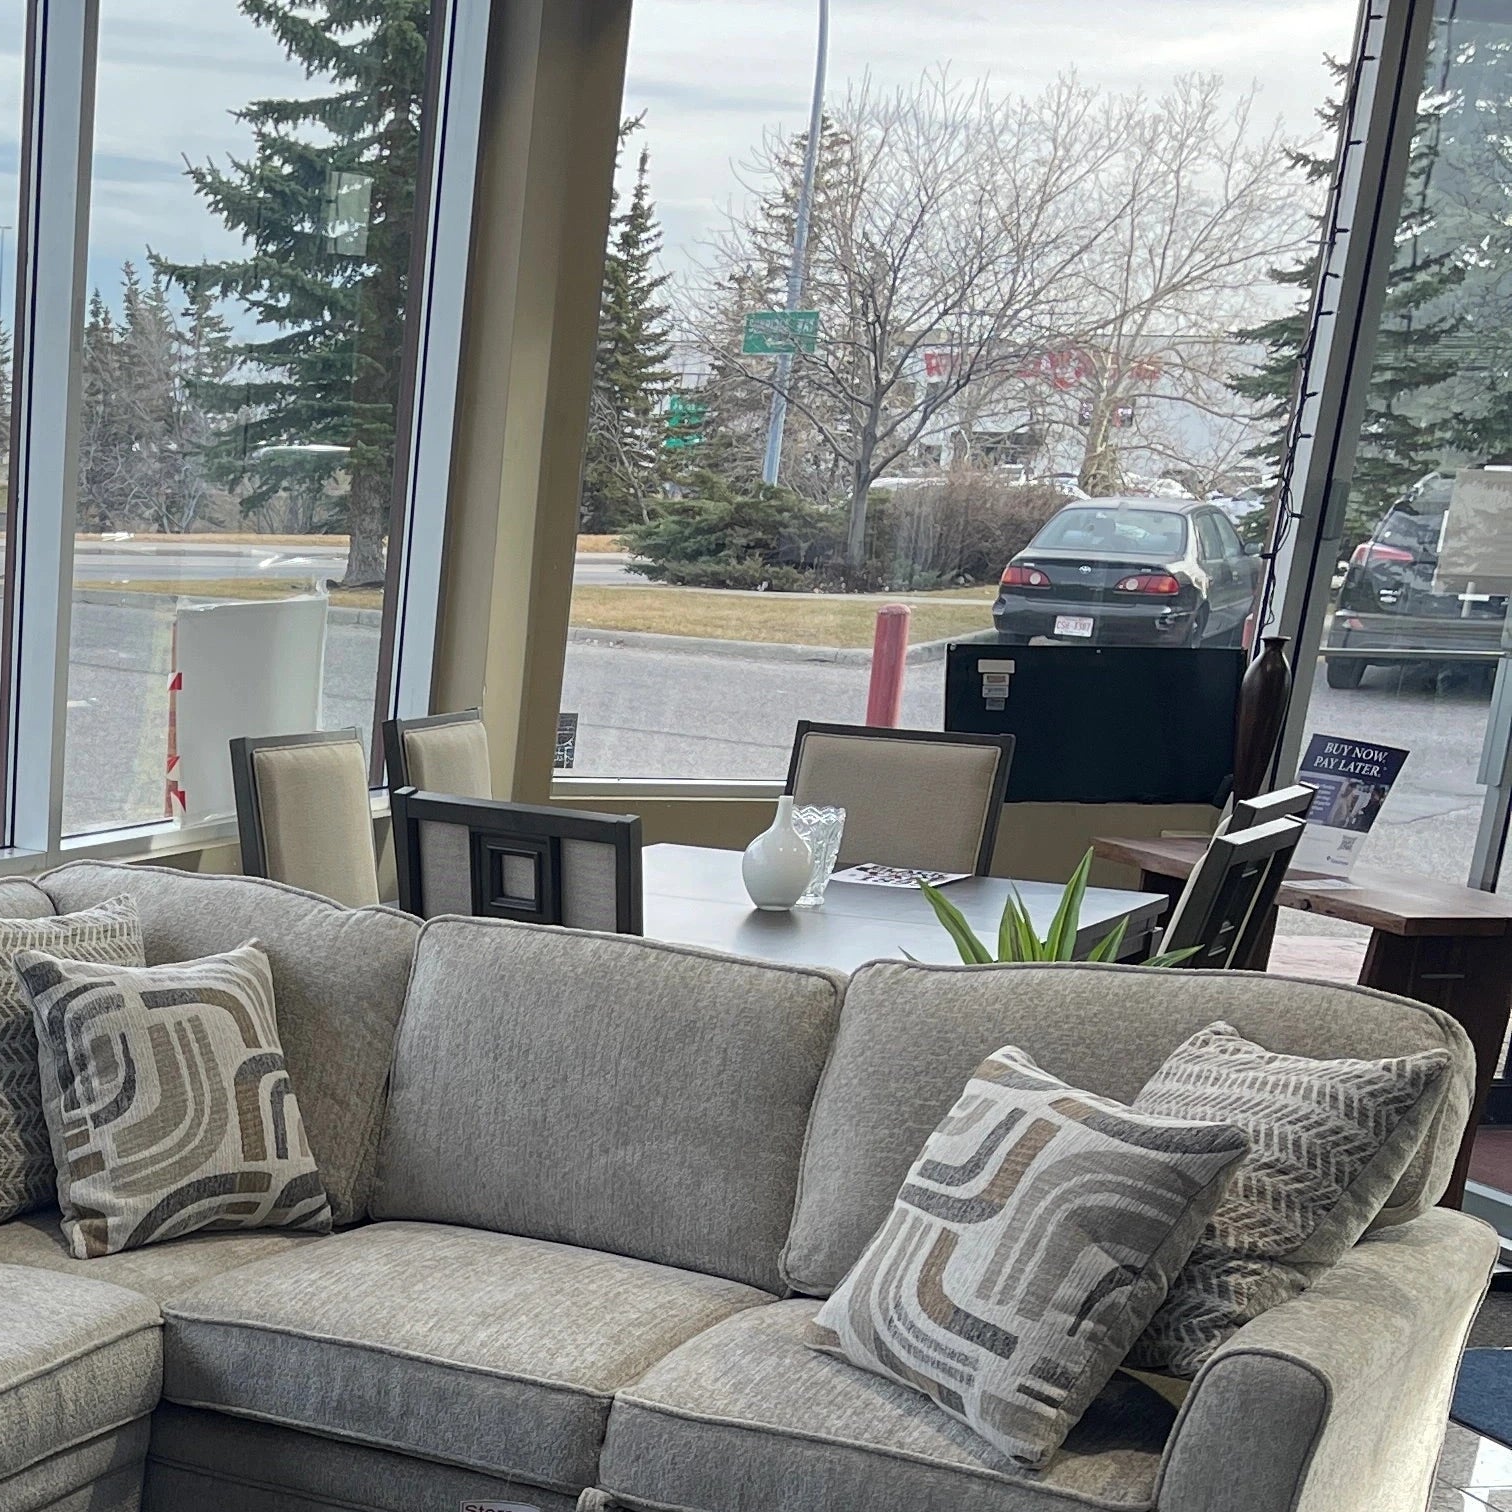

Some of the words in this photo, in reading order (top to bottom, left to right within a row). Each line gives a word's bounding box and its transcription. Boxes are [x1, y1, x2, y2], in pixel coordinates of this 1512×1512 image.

[1324, 742, 1352, 756] BUY
[1313, 755, 1339, 769] PAY
[1338, 761, 1381, 777] LATER.
